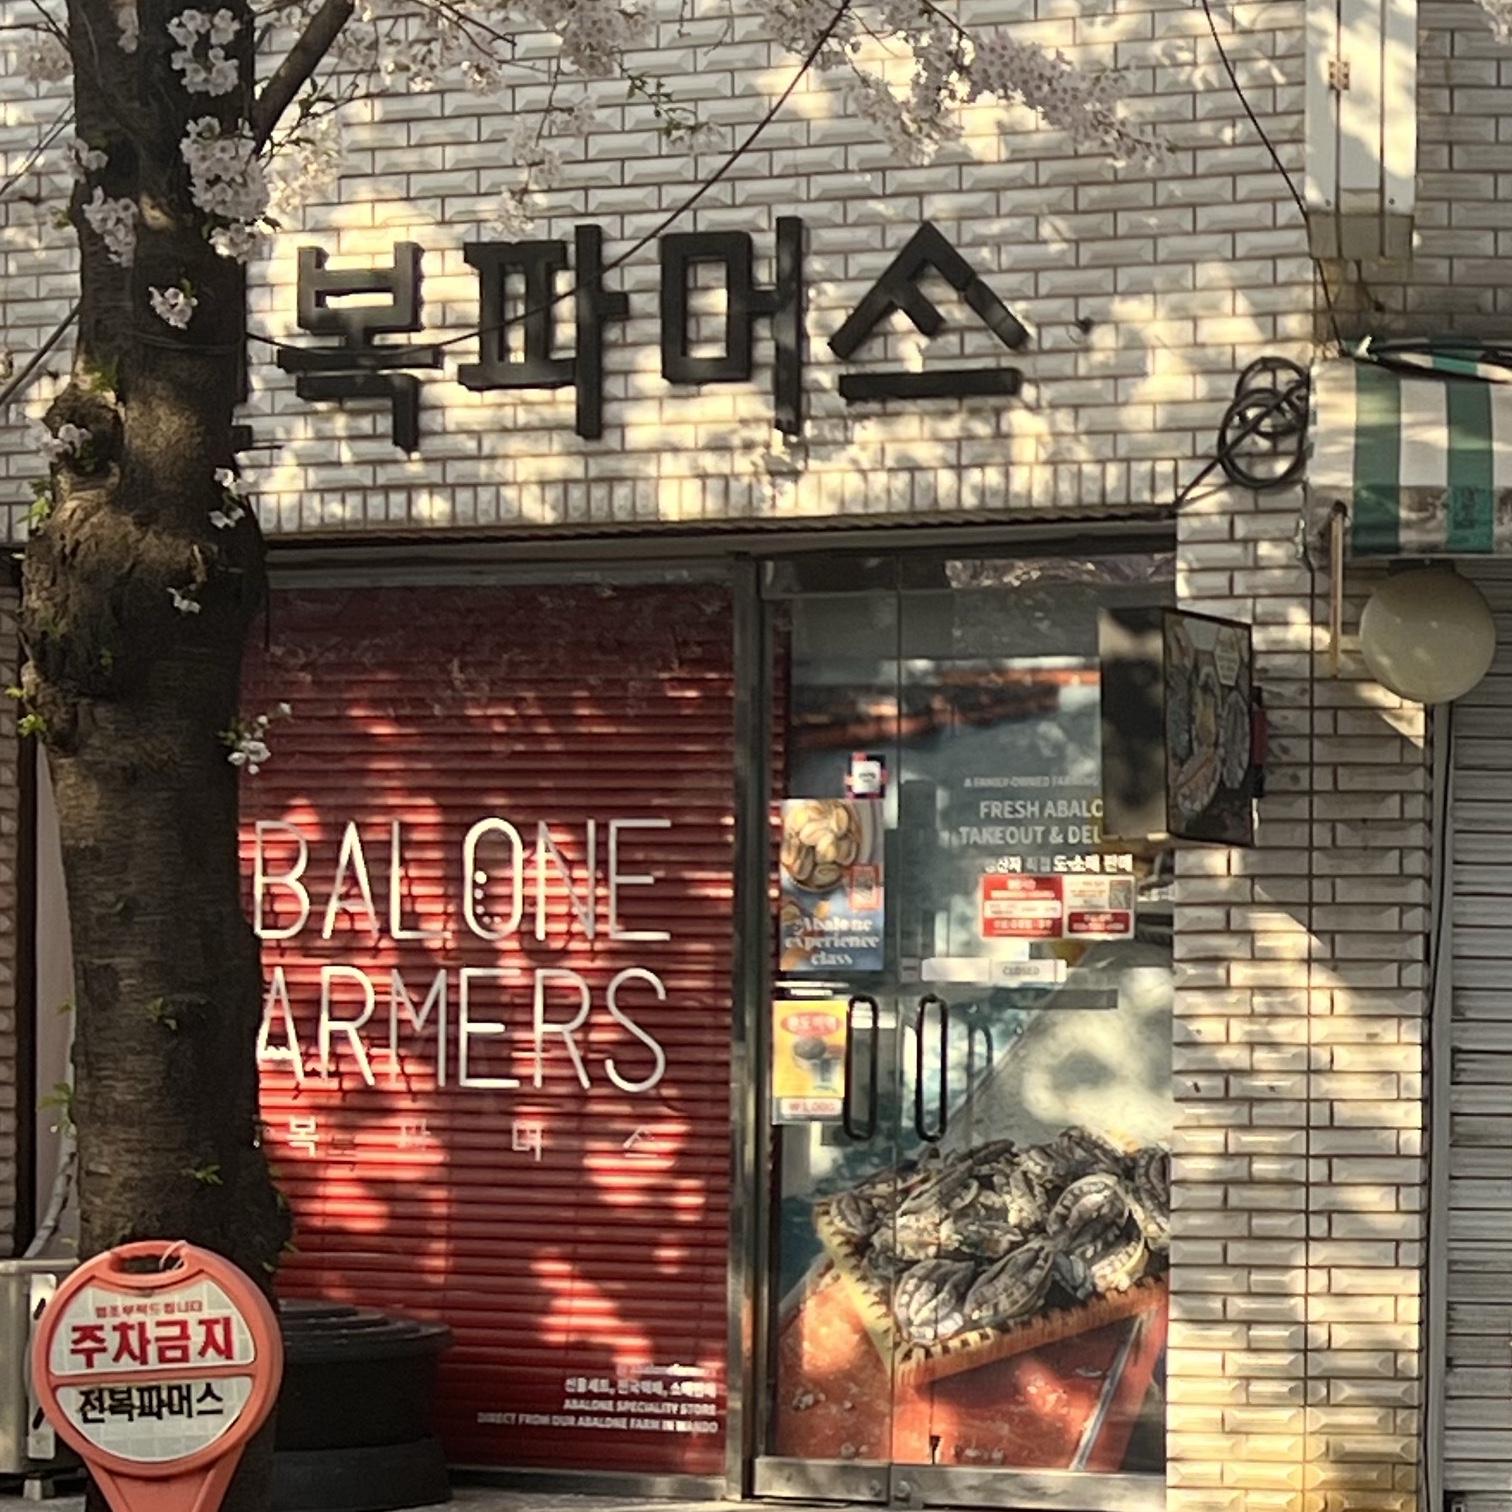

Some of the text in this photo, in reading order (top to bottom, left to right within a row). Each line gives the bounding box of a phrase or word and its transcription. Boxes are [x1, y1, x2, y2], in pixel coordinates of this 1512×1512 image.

[276, 216, 1031, 453] 복파머스
[980, 799, 1103, 819] FRESH ABALO
[958, 825, 1102, 845] TAKEOUT & DEL
[253, 817, 672, 941] BALONE
[785, 932, 879, 950] experience
[811, 951, 853, 966] class
[256, 966, 666, 1093] ARMERS
[70, 1316, 234, 1369] 주차금지
[79, 1382, 223, 1424] 전복파머스
[563, 1399, 614, 1412] ABALONE
[680, 1403, 717, 1416] STORE
[477, 1412, 516, 1425] DIRECT
[518, 1413, 549, 1426] FROM
[552, 1414, 575, 1427] OUR
[577, 1416, 628, 1430] ABALONE
